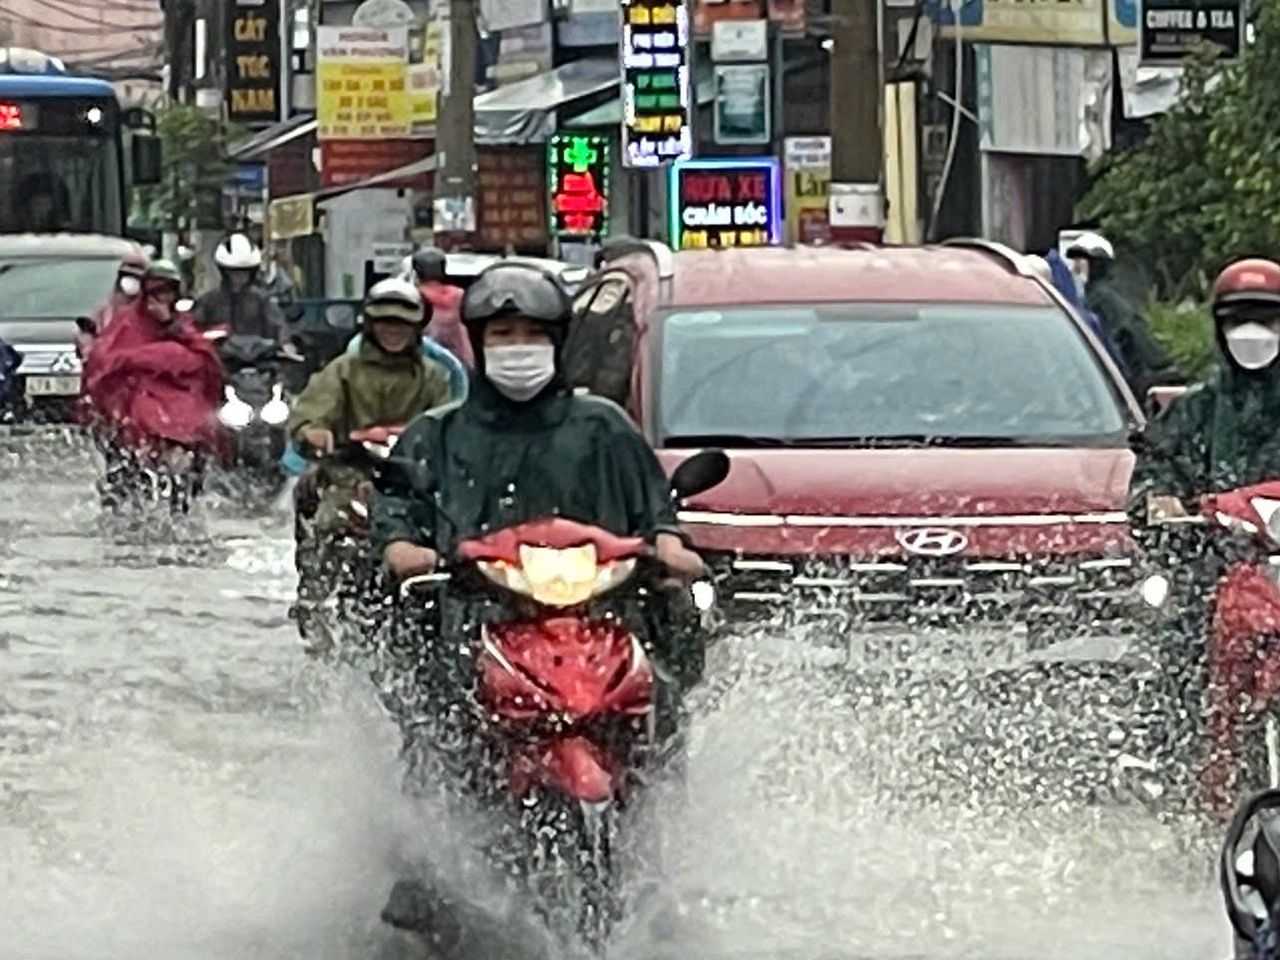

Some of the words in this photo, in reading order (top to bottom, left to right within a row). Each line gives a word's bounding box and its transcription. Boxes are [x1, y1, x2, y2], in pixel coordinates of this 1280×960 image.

[1147, 9, 1193, 28] COFFEE
[1211, 9, 1234, 28] TEA
[231, 88, 274, 112] NAM
[737, 173, 767, 199] XE
